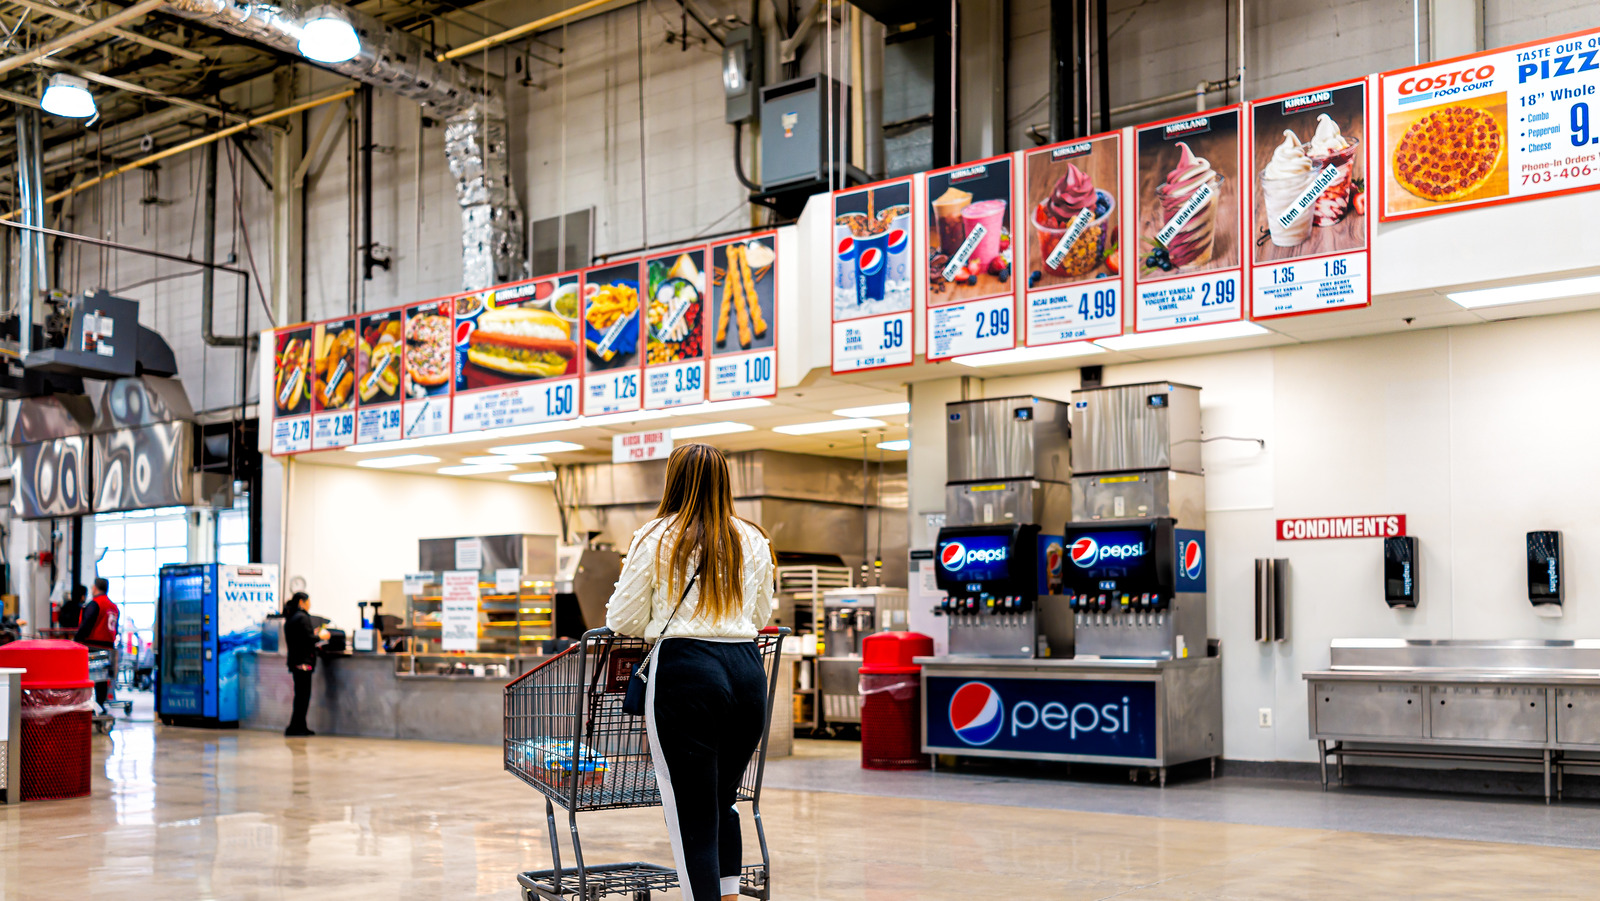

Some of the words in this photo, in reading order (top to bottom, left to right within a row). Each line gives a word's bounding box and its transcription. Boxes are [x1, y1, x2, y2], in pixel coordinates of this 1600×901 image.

[1516, 47, 1551, 62] TASTE
[1556, 41, 1582, 54] OUR
[1588, 37, 1600, 48] Q
[1518, 49, 1600, 84] PIZZ
[1397, 65, 1495, 95] COSTCO
[1434, 87, 1460, 98] FOOD
[1462, 80, 1494, 92] COURT
[1284, 91, 1330, 108] KIRKLAND
[1550, 84, 1596, 101] Whole
[1166, 118, 1208, 133] KIRKLAND
[1527, 112, 1549, 123] Combo
[1528, 124, 1560, 138] Pepperoni
[1528, 142, 1552, 153] Cheese
[1521, 159, 1562, 172] Phone-In
[1565, 153, 1596, 165] Orders
[1521, 164, 1600, 186] 703-406-
[1279, 208, 1299, 226] Item
[1298, 168, 1338, 208] unavailable
[1158, 226, 1176, 243] Item
[1175, 187, 1210, 225] unavailable
[957, 227, 984, 262] unavailable
[1049, 250, 1066, 268] Item
[1063, 211, 1092, 250] unavailable
[1273, 266, 1295, 284] 1.35
[1324, 258, 1347, 277] 1.65
[1032, 298, 1047, 306] ACAI
[1049, 295, 1068, 304] BOWL
[1142, 290, 1167, 299] NONFAT
[1169, 286, 1196, 295] VANILLA
[1145, 296, 1169, 306] YOGURT
[1201, 278, 1235, 307] 2.99
[1078, 288, 1116, 321] 4.99
[879, 318, 903, 350] .59
[976, 307, 1010, 339] 2.99
[675, 365, 701, 392] 3.99
[745, 356, 771, 384] 1.00
[614, 374, 637, 400] 1.25
[545, 384, 573, 417] 1.50
[292, 420, 310, 441] 2.79
[334, 414, 353, 436] 2.99
[1282, 516, 1399, 539] CONDIMENTS
[966, 546, 1006, 565] pepsi
[1100, 541, 1143, 560] pepsi
[225, 591, 274, 602] WATER
[1011, 696, 1129, 739] pepsi
